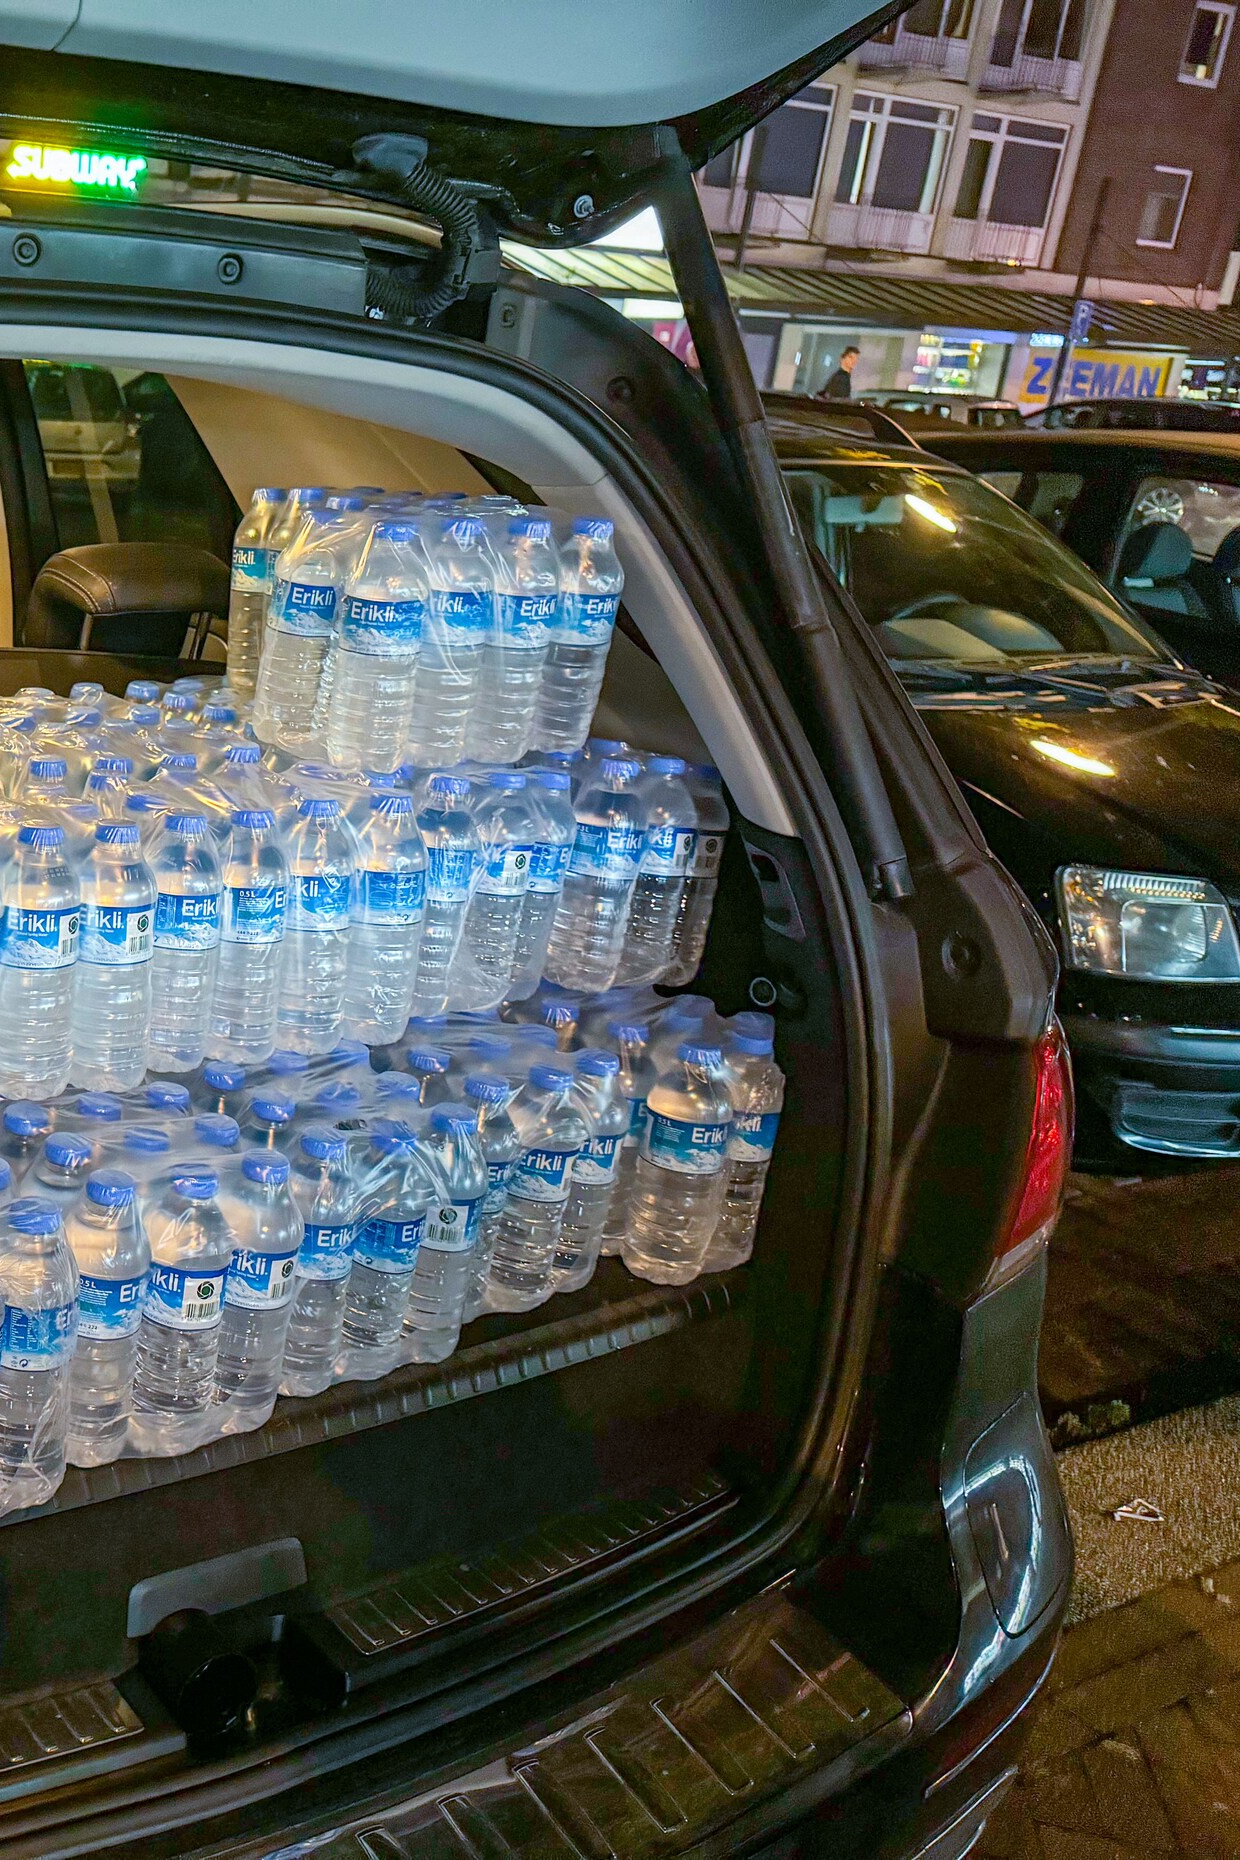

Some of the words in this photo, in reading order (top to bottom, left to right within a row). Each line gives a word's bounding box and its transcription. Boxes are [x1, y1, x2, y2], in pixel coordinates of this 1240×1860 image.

[6, 143, 147, 194] SUBWAY
[1026, 356, 1161, 398] ZEMAN
[291, 586, 333, 606] Erikli
[436, 595, 465, 613] ikli
[350, 600, 395, 623] Erikli
[7, 912, 56, 933] Erikli
[579, 1138, 614, 1155] rikli
[317, 1229, 352, 1248] Erik
[229, 1250, 267, 1275] rikli
[152, 1269, 179, 1293] ikli
